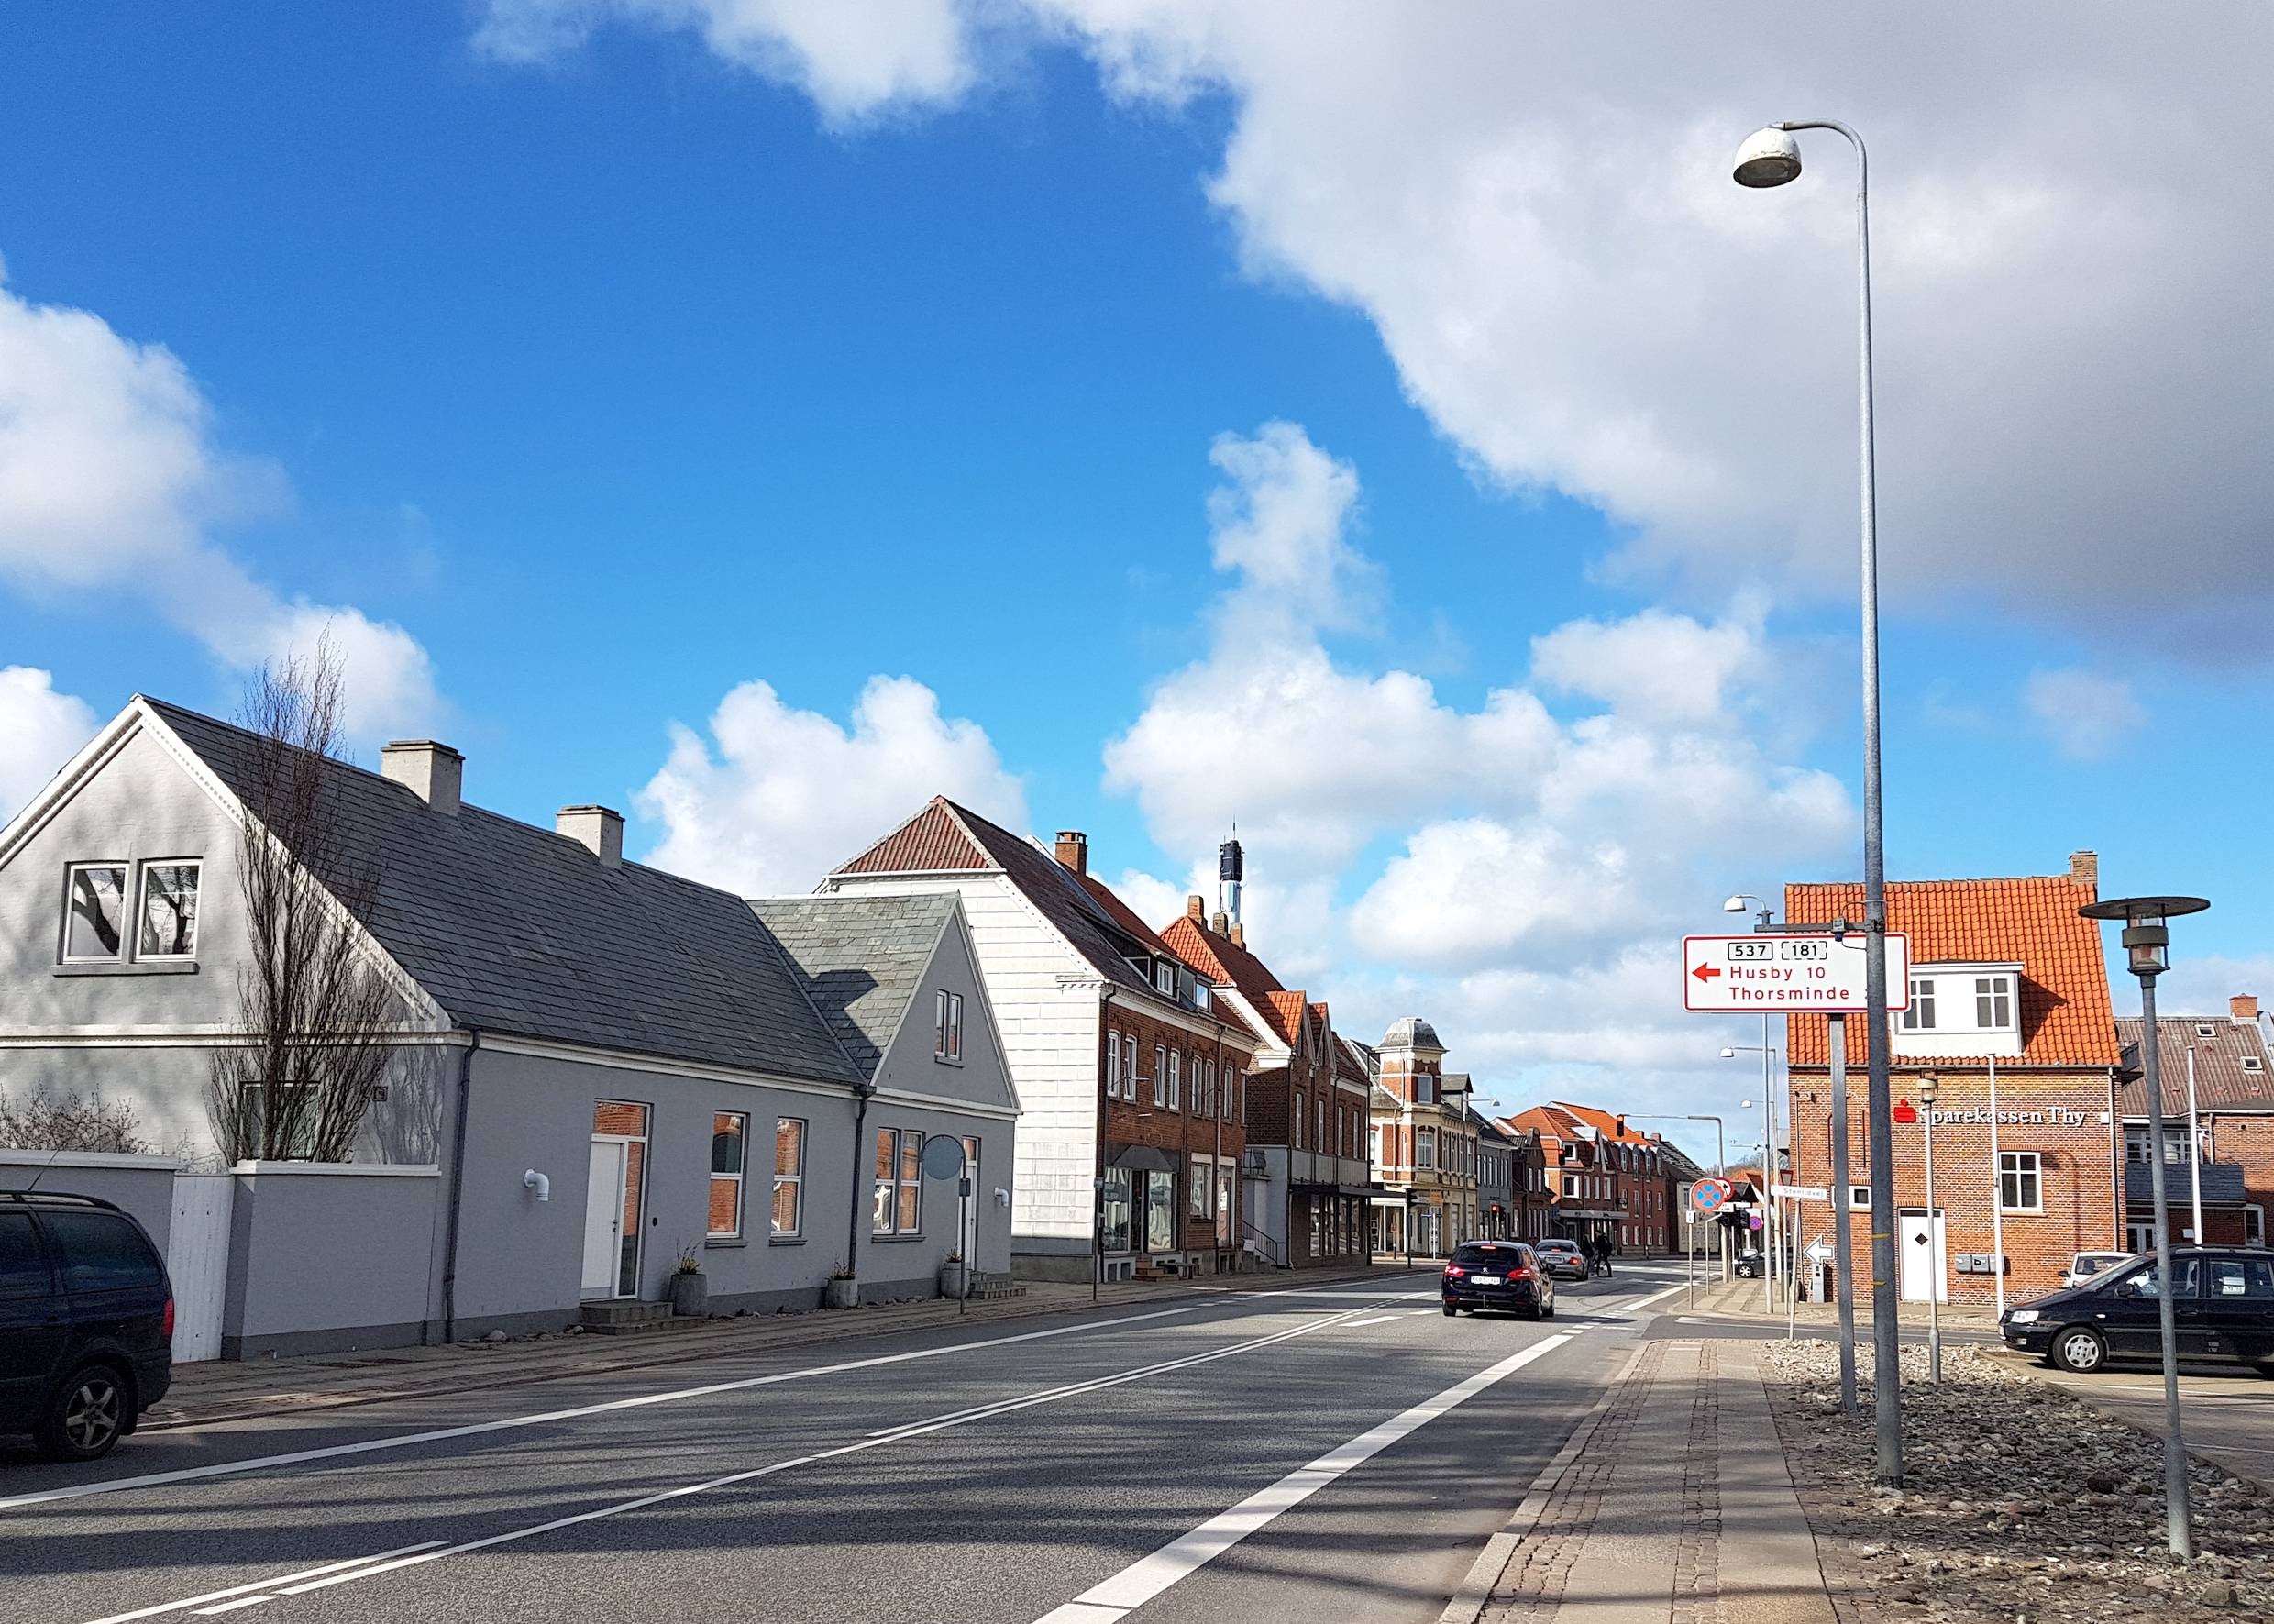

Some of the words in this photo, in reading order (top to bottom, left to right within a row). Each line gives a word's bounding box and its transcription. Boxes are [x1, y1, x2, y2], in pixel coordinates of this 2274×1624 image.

[1735, 945, 1766, 956] 537
[1792, 945, 1817, 956] 181
[1730, 966, 1793, 981] Husby
[1807, 967, 1826, 978] 10
[1729, 987, 1849, 1000] Thorsminde
[2047, 1106, 2086, 1126] Thy
